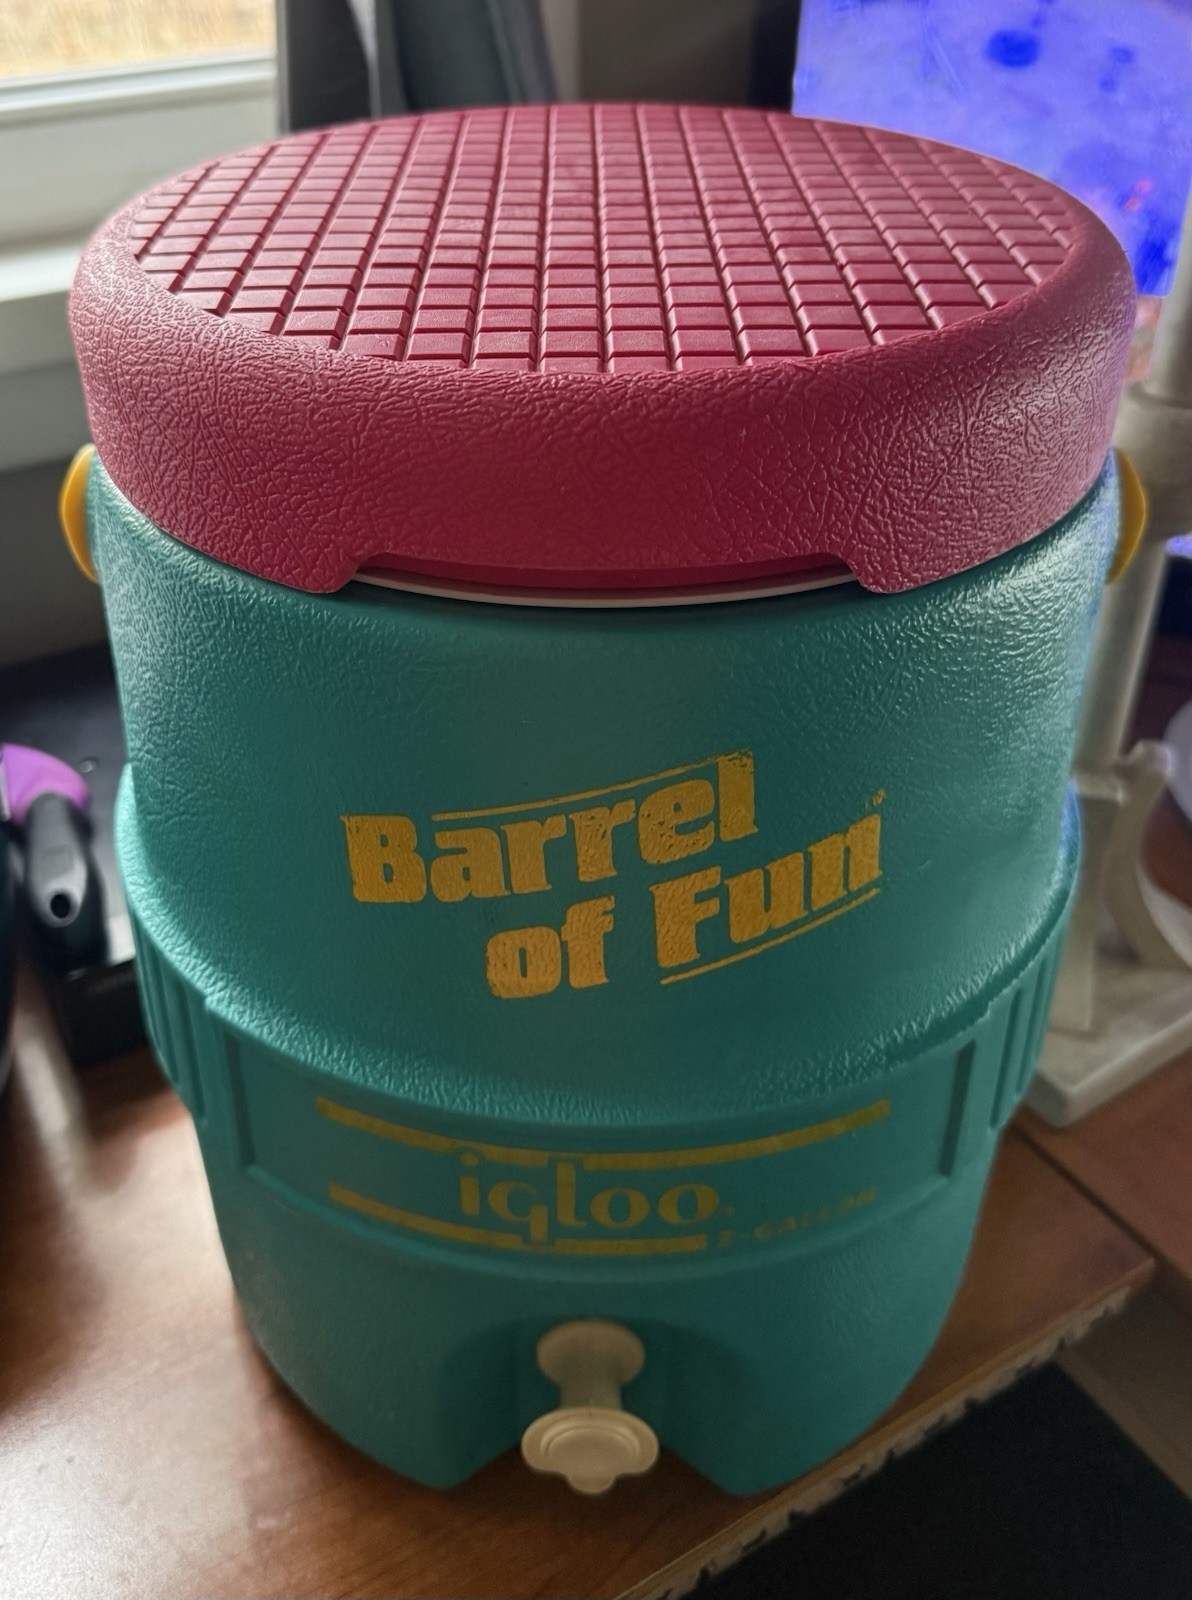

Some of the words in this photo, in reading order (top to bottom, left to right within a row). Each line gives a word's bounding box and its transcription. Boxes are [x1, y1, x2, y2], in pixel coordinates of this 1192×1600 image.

[341, 749, 758, 903] Barrel
[486, 895, 615, 999] of
[649, 814, 882, 969] Fun
[460, 1152, 719, 1242] igloo
